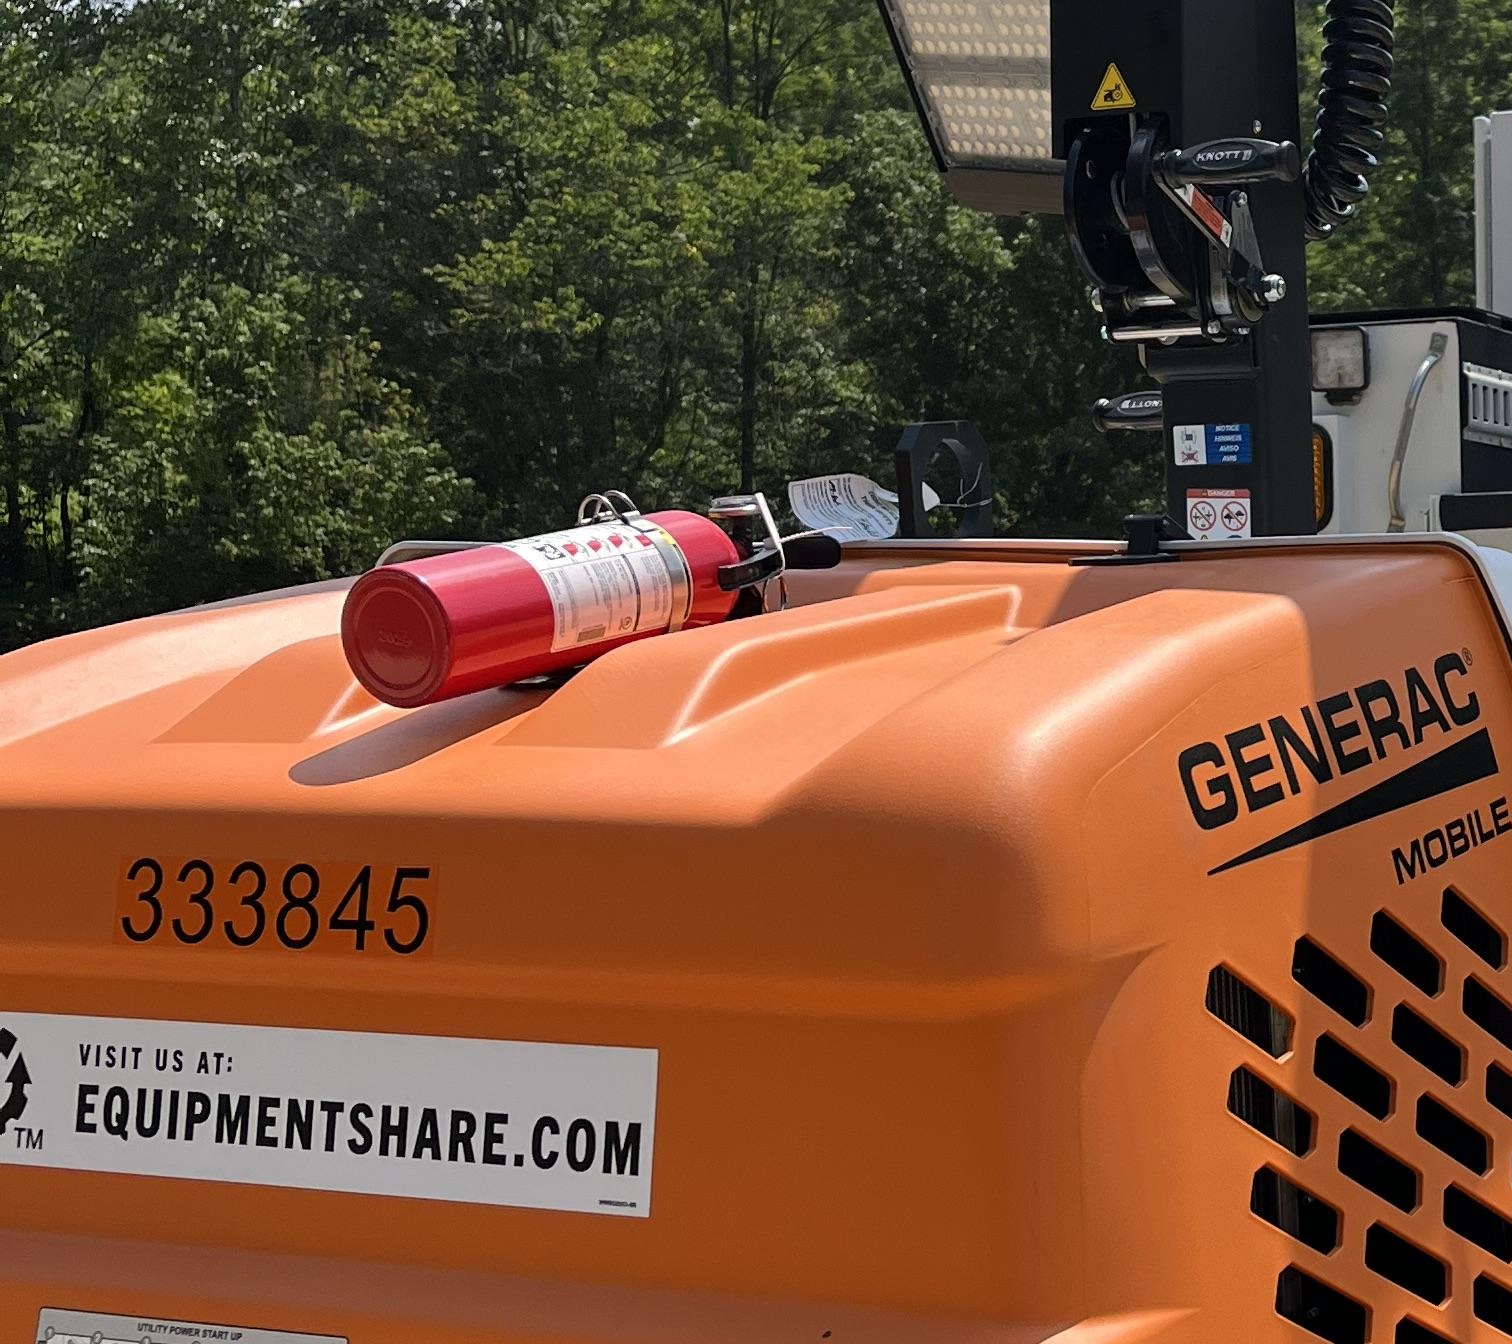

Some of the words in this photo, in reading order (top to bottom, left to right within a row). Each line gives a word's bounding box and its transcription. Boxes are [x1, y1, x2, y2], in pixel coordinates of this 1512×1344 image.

[1195, 150, 1240, 162] KNOTT
[1178, 652, 1480, 831] GENERAC
[1391, 796, 1512, 886] MOBILE
[119, 858, 432, 955] 333845
[79, 1043, 143, 1070] VISIT
[155, 1048, 184, 1073] US
[196, 1051, 233, 1075] AT:
[14, 1127, 44, 1150] TM
[75, 1083, 641, 1177] EQUIPMENTSHARE.COM
[137, 1322, 168, 1334] UTILITY
[169, 1326, 200, 1338] POWER
[202, 1329, 229, 1341] START
[230, 1332, 243, 1342] UP
